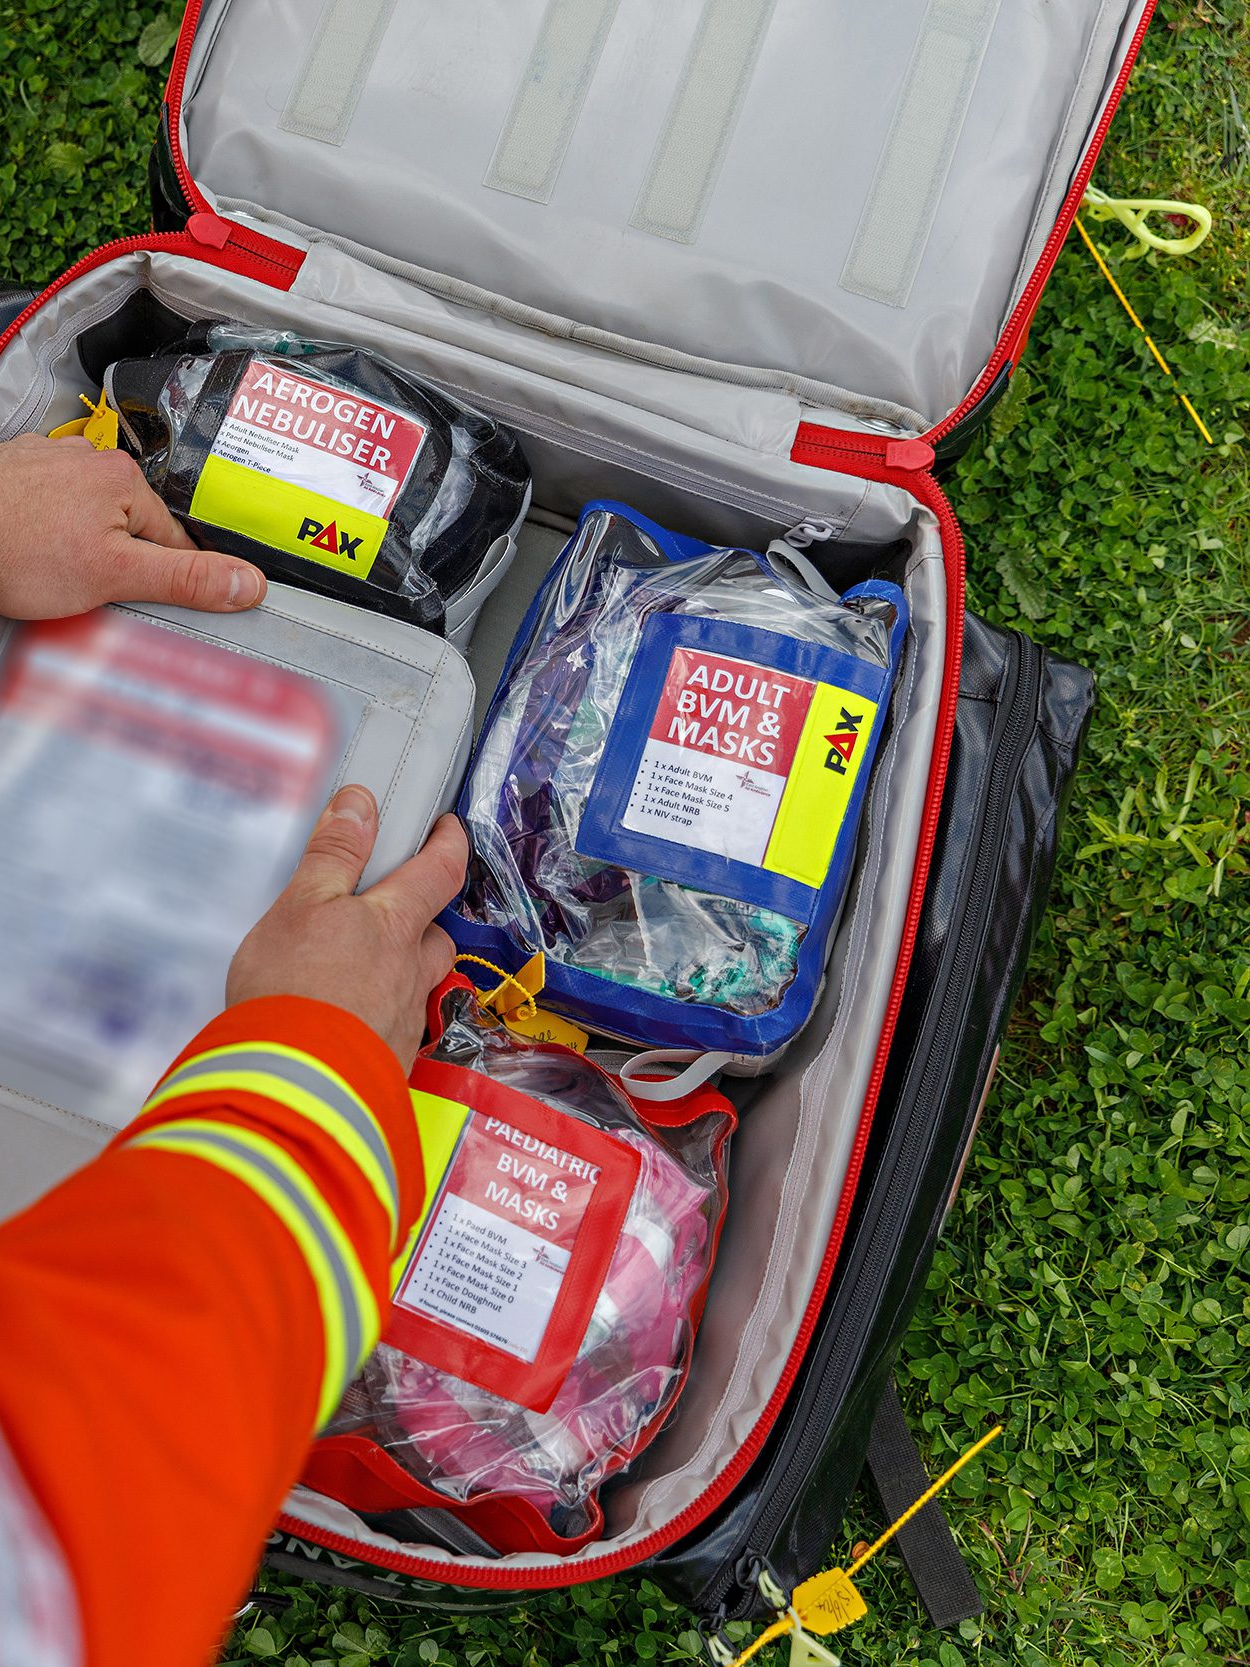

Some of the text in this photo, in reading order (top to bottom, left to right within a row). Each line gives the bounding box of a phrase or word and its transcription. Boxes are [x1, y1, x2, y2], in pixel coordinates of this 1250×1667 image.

[252, 372, 396, 439] AEROGEN
[225, 431, 243, 443] Paed
[243, 438, 275, 454] Nebuliser
[276, 450, 295, 462] Mask
[229, 424, 248, 435] Adult
[248, 430, 280, 446] Nebuliser
[281, 442, 300, 454] Mask
[232, 394, 391, 471] NEBULISER
[218, 449, 246, 464] Aerogen
[247, 459, 271, 474] T-Piece
[297, 517, 364, 561] PAX
[686, 665, 791, 709] ADULT
[676, 689, 781, 739] BVM &
[668, 717, 776, 765] MASKS
[823, 706, 864, 776] PAX
[664, 775, 683, 787] Face
[685, 781, 708, 794] Mask
[709, 788, 726, 799] Size
[667, 765, 690, 776] Adult
[692, 771, 713, 783] BVM
[640, 805, 645, 813] 1
[654, 809, 670, 819] NIV
[670, 815, 692, 827] strap
[657, 798, 680, 810] Adult
[682, 804, 700, 816] NRB
[661, 786, 680, 798] Face
[681, 792, 704, 805] Mask
[705, 799, 722, 810] Size
[723, 804, 730, 812] 5
[485, 1117, 601, 1184] PAEDIATRIC
[496, 1153, 568, 1203] BVM &
[485, 1181, 560, 1230] MASKS
[461, 1231, 479, 1246] Face
[480, 1241, 502, 1257] Mask
[503, 1252, 520, 1266] Size
[520, 1261, 527, 1269] 3
[466, 1219, 487, 1235] Paed
[487, 1230, 507, 1245] BVM
[451, 1254, 470, 1269] Face
[471, 1264, 493, 1280] Mask
[495, 1275, 511, 1289] Size
[513, 1284, 518, 1292] 1
[456, 1242, 475, 1256] Face
[476, 1253, 498, 1269] Mask
[499, 1264, 516, 1277] Size
[516, 1272, 523, 1281] 2
[436, 1289, 458, 1305] Child
[458, 1300, 477, 1314] NRB
[441, 1277, 460, 1292] Face
[461, 1287, 502, 1312] Doughnut
[446, 1266, 466, 1280] Face
[466, 1275, 489, 1292] Mask
[490, 1287, 507, 1300] Size
[507, 1295, 514, 1304] 0
[372, 1572, 524, 1595] AST
